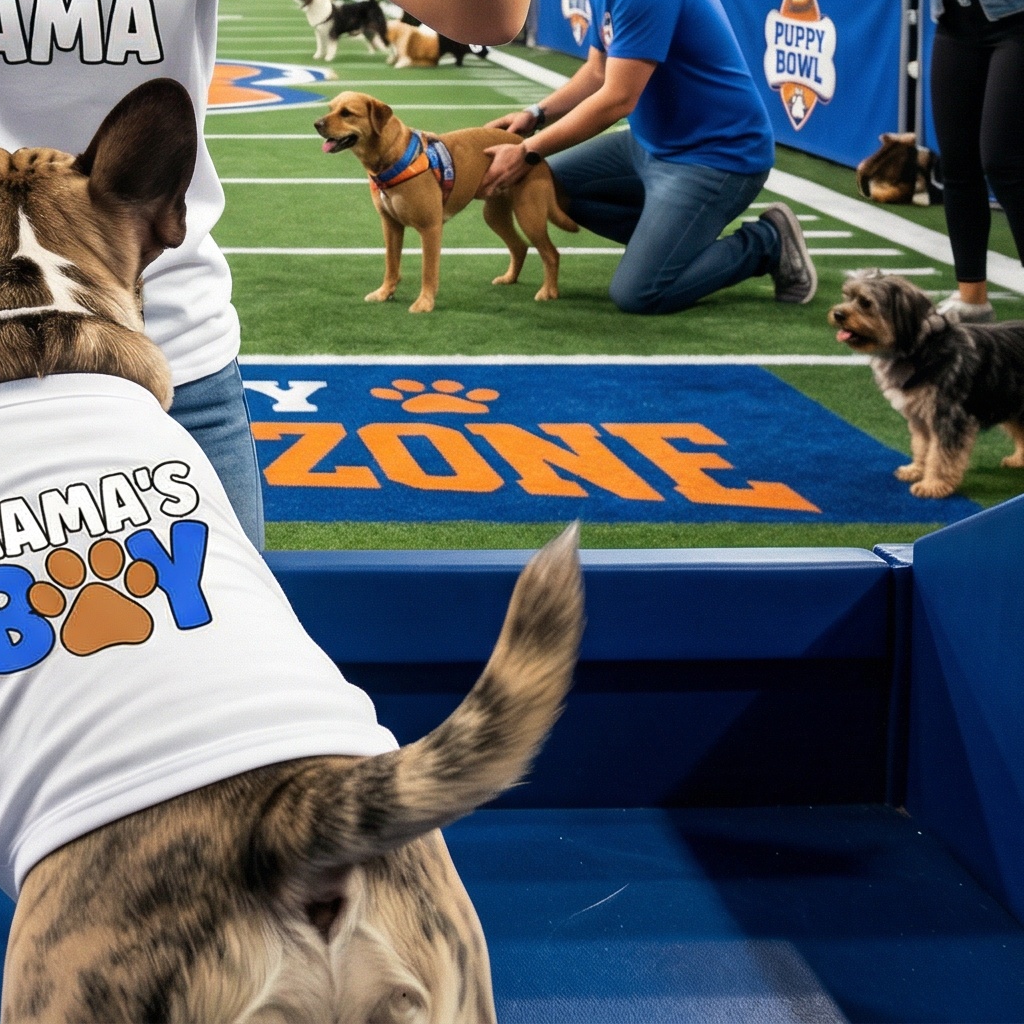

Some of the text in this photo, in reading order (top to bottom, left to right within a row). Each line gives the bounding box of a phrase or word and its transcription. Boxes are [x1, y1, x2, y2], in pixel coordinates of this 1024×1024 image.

[774, 21, 825, 53] PUPPY
[775, 49, 822, 85] BOWL
[249, 421, 823, 514] ZONE
